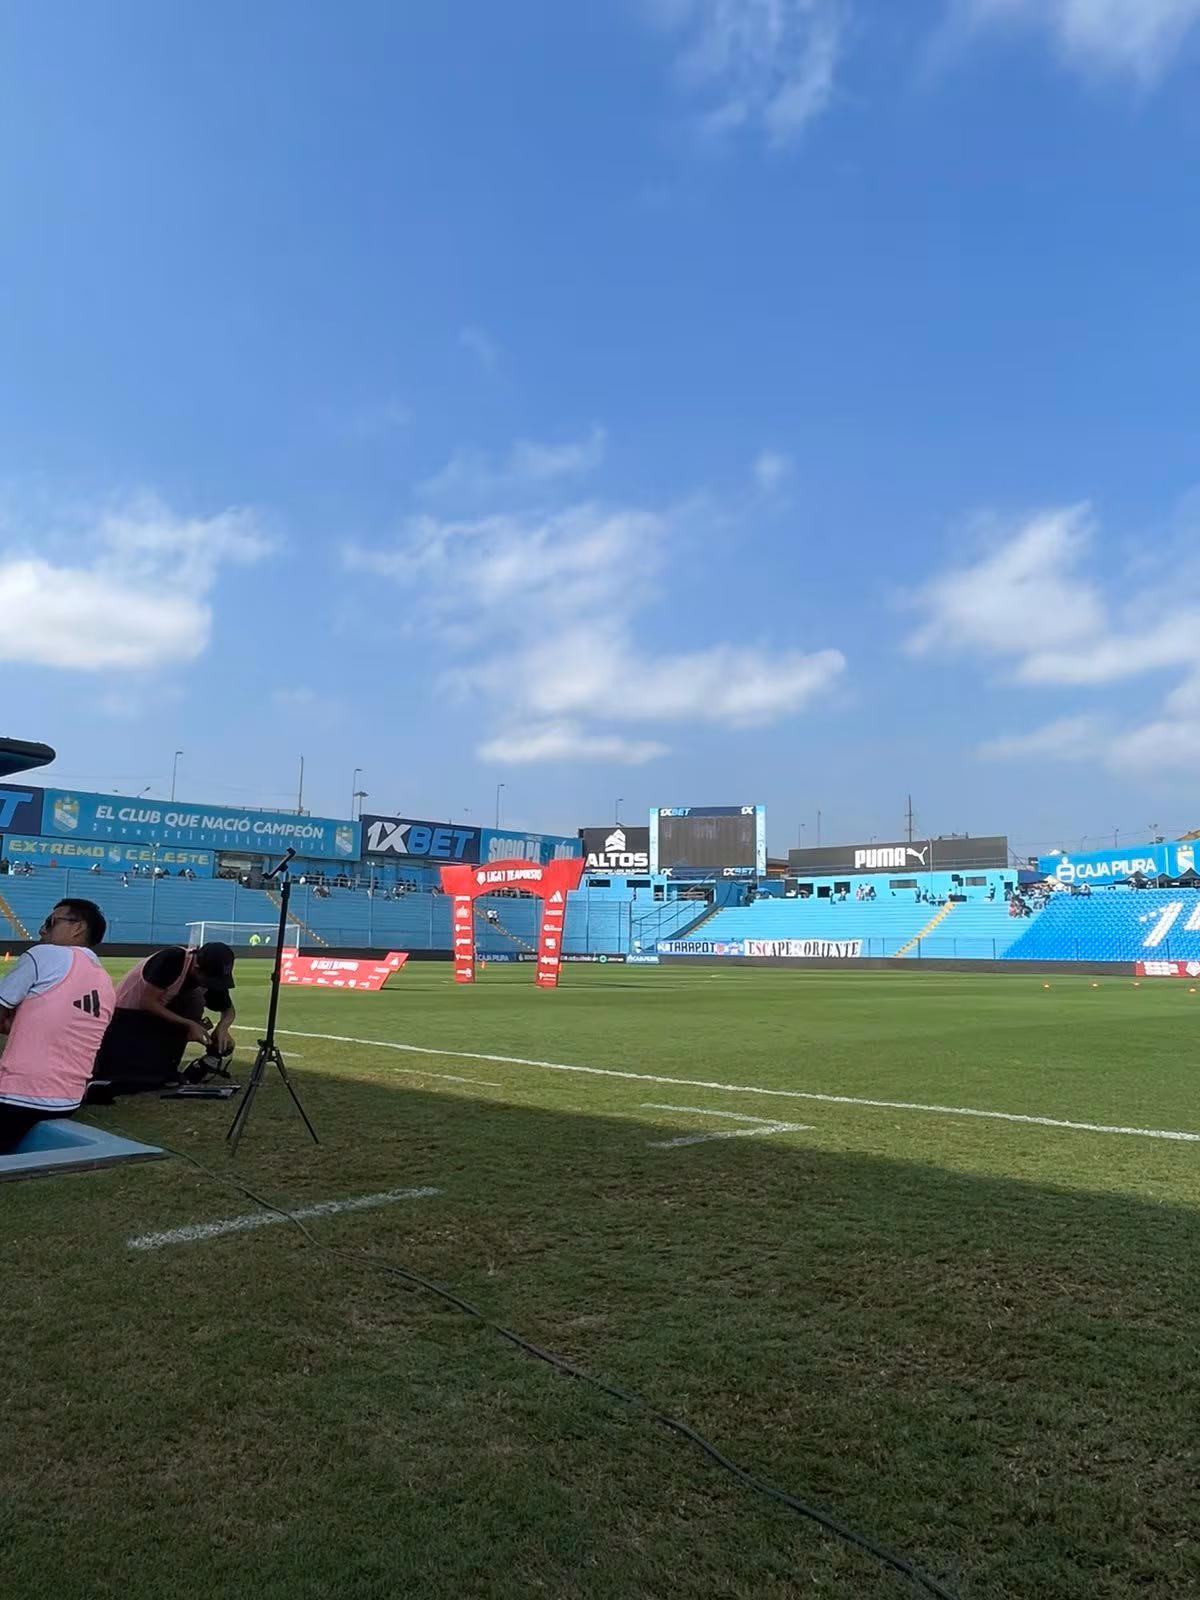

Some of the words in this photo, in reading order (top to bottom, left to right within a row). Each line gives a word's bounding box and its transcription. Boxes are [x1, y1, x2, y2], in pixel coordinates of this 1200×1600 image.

[96, 805, 115, 819] EL
[118, 808, 161, 824] CLUB
[164, 812, 200, 828] QUE
[201, 815, 250, 832] NACIÓ
[253, 821, 324, 839] CAMPEÓN
[660, 808, 691, 816] 1XBET
[367, 821, 474, 858] 1XBET
[9, 840, 104, 857] EXTREMO
[125, 850, 209, 865] CELESTE
[585, 853, 648, 867] ALTOS
[854, 847, 906, 868] PUMA
[723, 867, 755, 876] 1XBET
[1076, 863, 1111, 879] CAJA
[1112, 858, 1157, 875] PIURA
[749, 941, 792, 956] ESCAPE
[804, 941, 859, 959] ORIENTE
